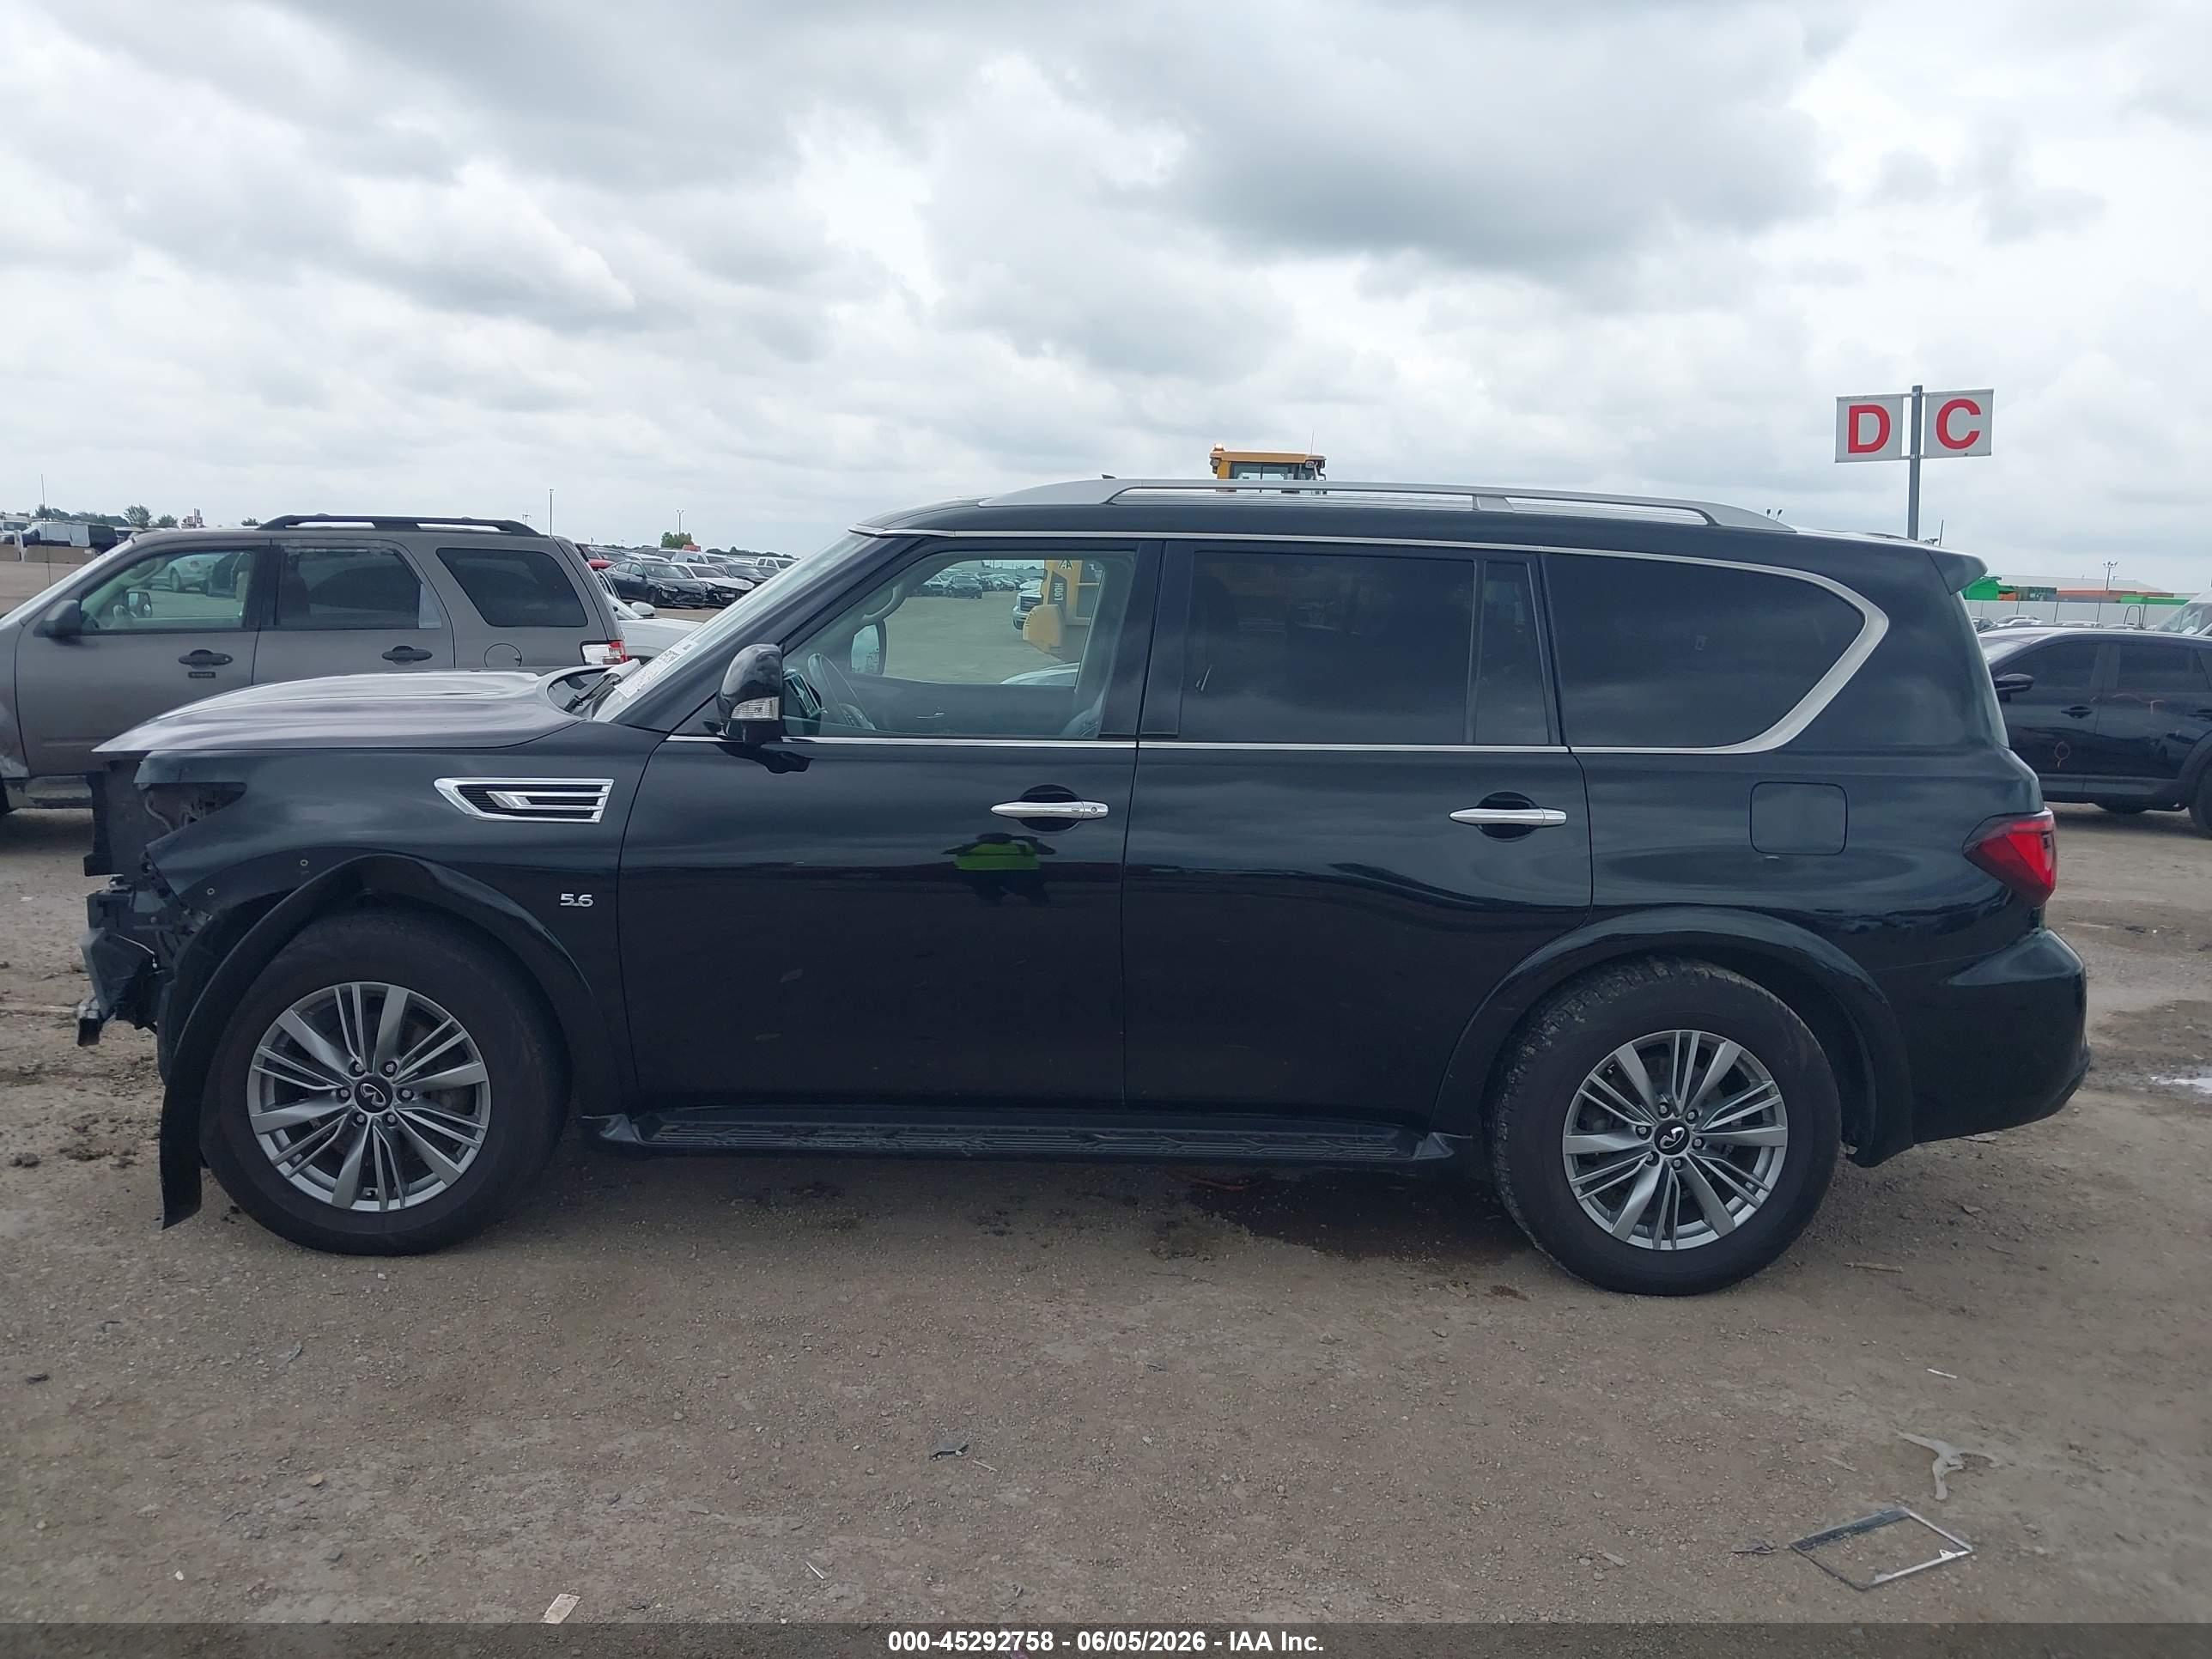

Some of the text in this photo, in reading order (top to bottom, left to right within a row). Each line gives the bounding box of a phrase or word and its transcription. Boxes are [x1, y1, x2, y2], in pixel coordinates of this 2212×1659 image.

[1848, 404, 1891, 453] D
[1936, 398, 1981, 449] C
[560, 893, 594, 908] 5.6
